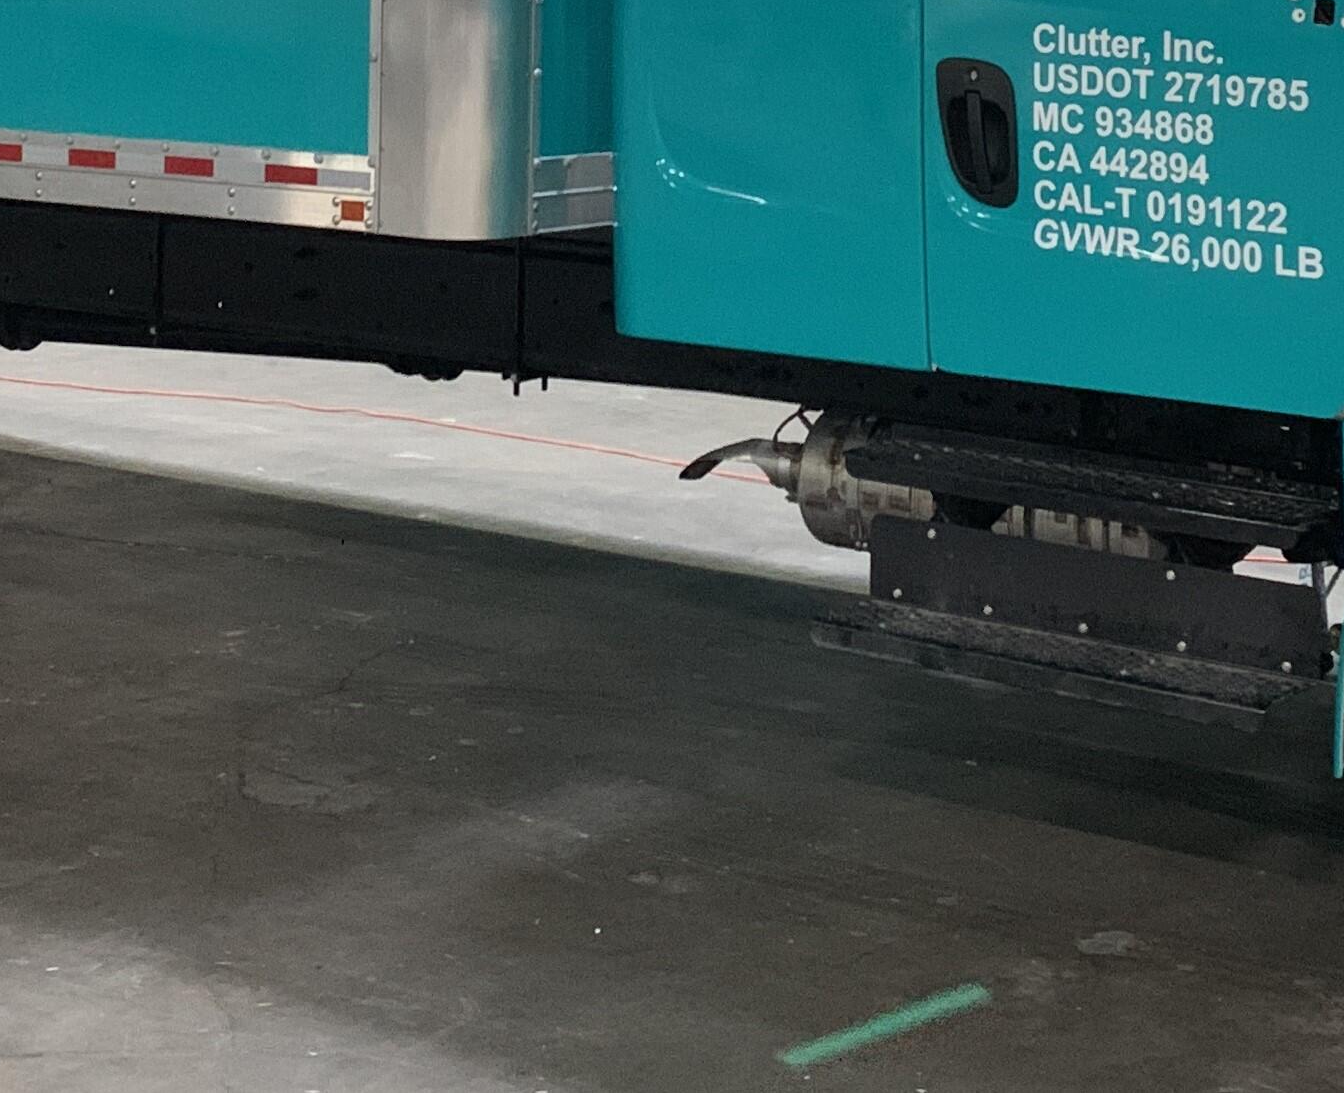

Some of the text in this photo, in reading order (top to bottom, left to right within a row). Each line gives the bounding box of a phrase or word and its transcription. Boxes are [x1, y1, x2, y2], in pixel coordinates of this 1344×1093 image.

[1032, 22, 1224, 65] Clutter, Inc.
[1032, 61, 1309, 111] USDOT 2719785
[1032, 101, 1214, 145] MC 934868
[1032, 140, 1209, 185] CA 442894
[1033, 179, 1288, 234] CAL-T 0191122
[1034, 218, 1324, 280] GVWR 26,000 LB
